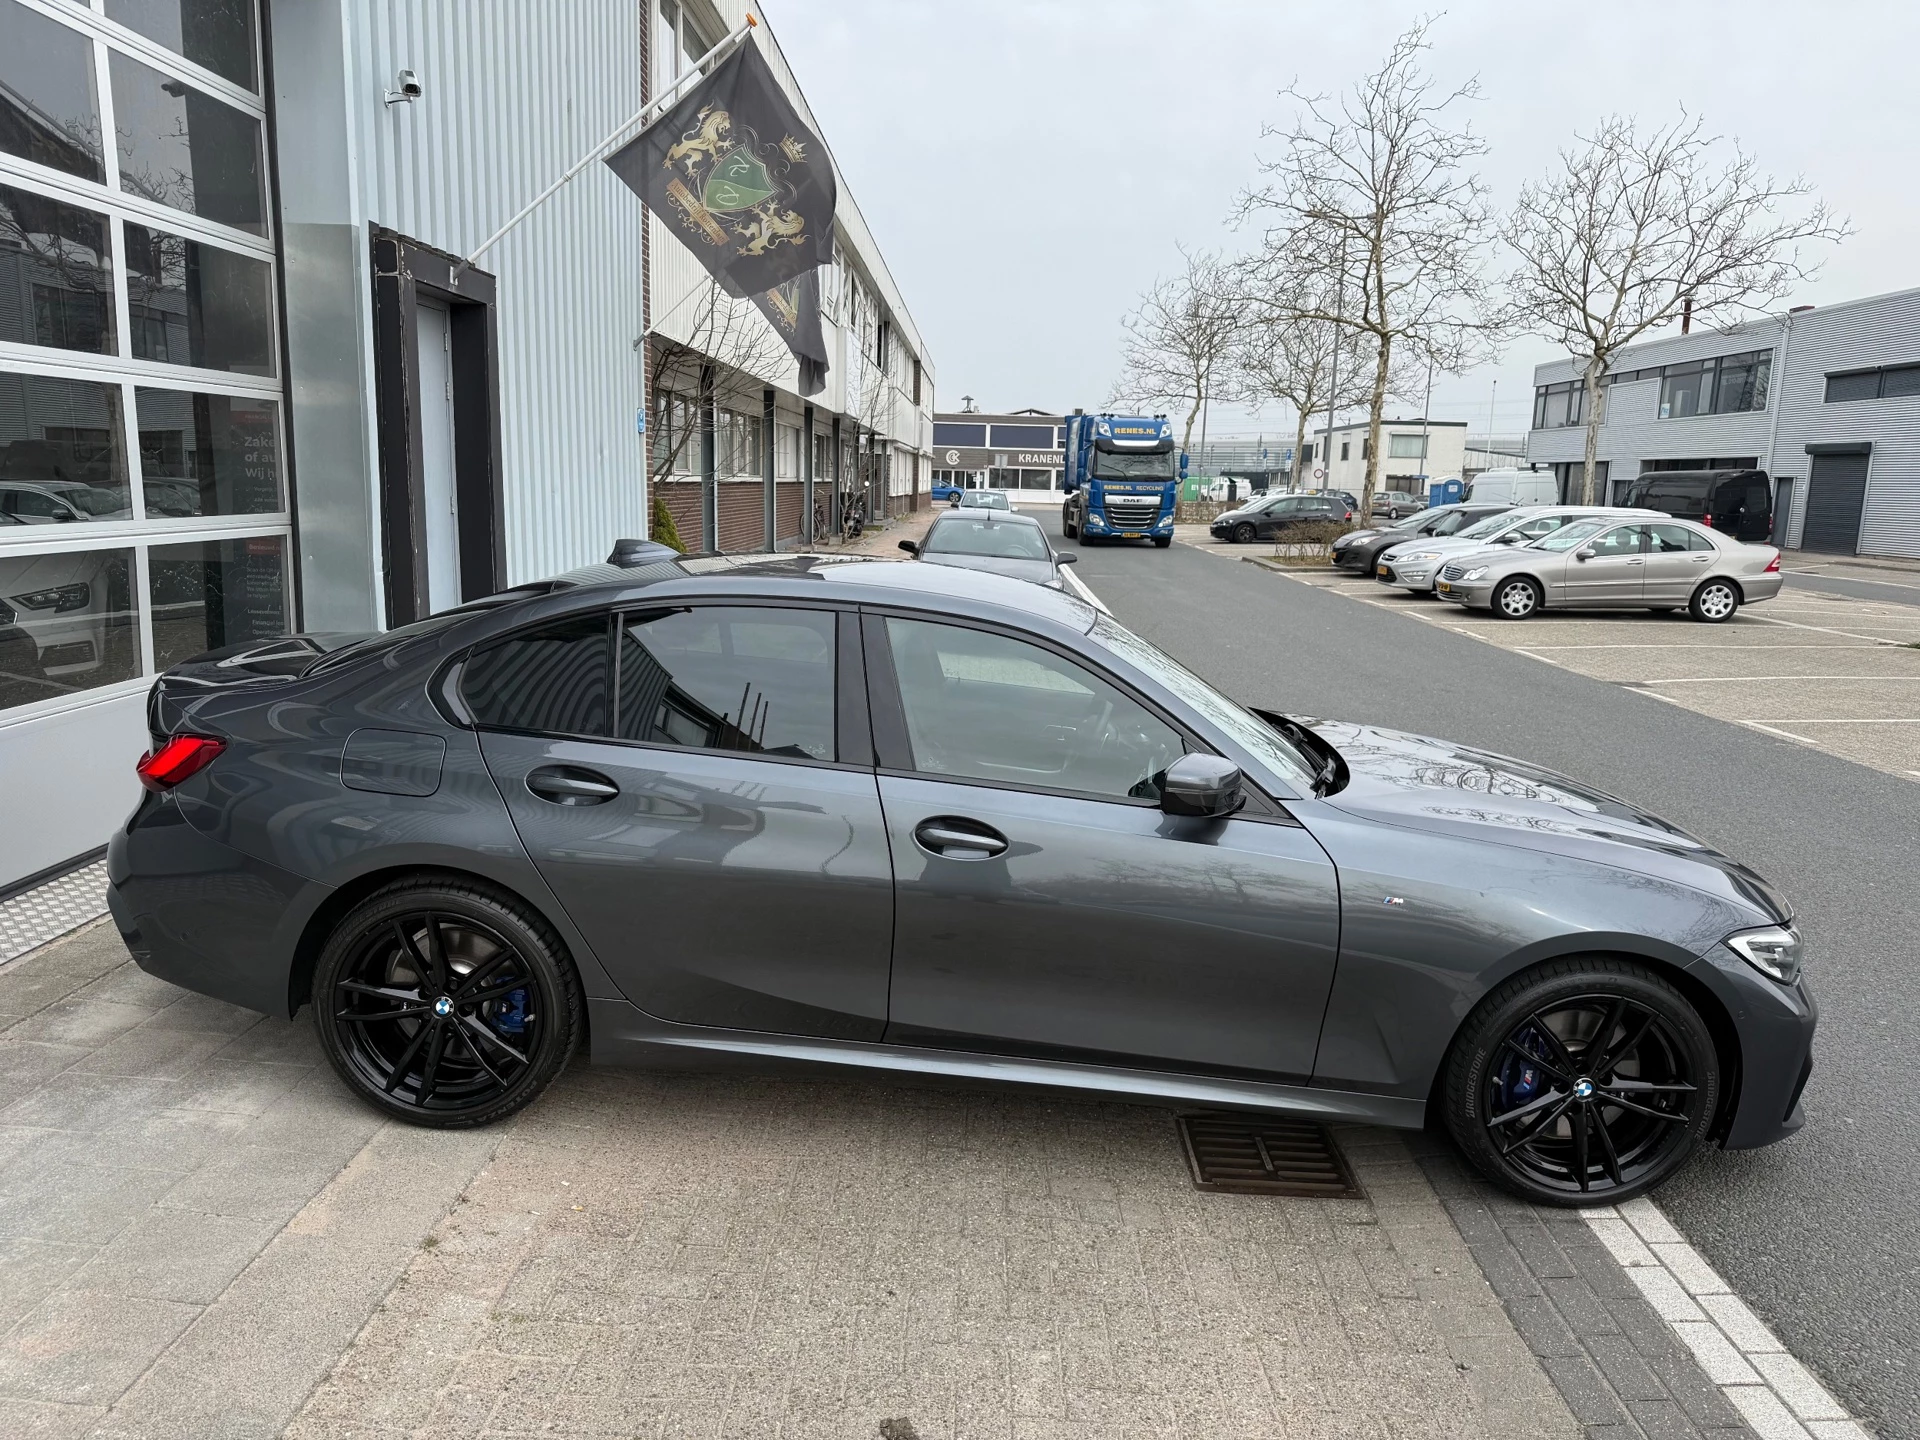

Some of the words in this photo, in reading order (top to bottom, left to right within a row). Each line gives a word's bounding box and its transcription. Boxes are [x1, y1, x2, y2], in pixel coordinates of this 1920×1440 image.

[671, 182, 704, 215] Autobedrijf
[700, 213, 725, 242] Rotterdam
[1114, 427, 1157, 435] RENES.NL
[244, 437, 275, 447] Zake
[244, 451, 258, 462] of
[245, 467, 264, 480] Wij
[268, 468, 276, 478] h
[1464, 1046, 1487, 1119] BRIDGESTONE
[1693, 1071, 1716, 1141] BRIDGESTONE
